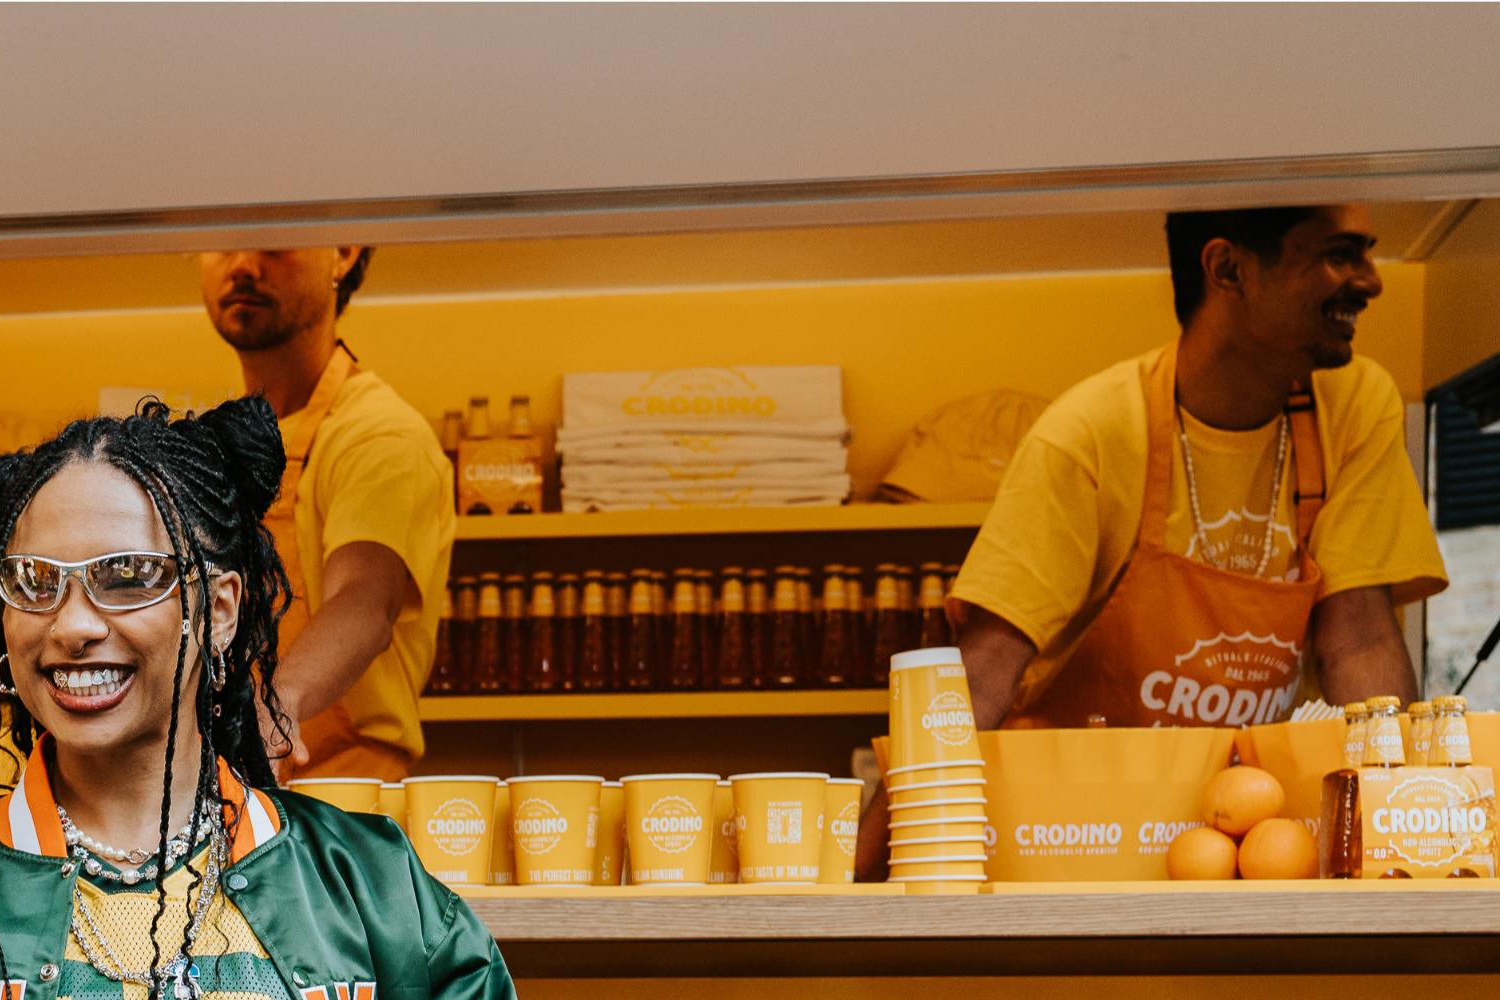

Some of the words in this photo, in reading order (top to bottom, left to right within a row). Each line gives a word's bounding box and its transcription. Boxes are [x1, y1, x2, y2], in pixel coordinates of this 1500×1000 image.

[621, 396, 777, 418] CRODINO
[1140, 671, 1300, 727] CRODIN
[427, 818, 486, 836] CRODINO
[641, 816, 703, 834] CRODINO
[1372, 807, 1487, 834] CRODINO
[1015, 823, 1123, 847] CRODINO
